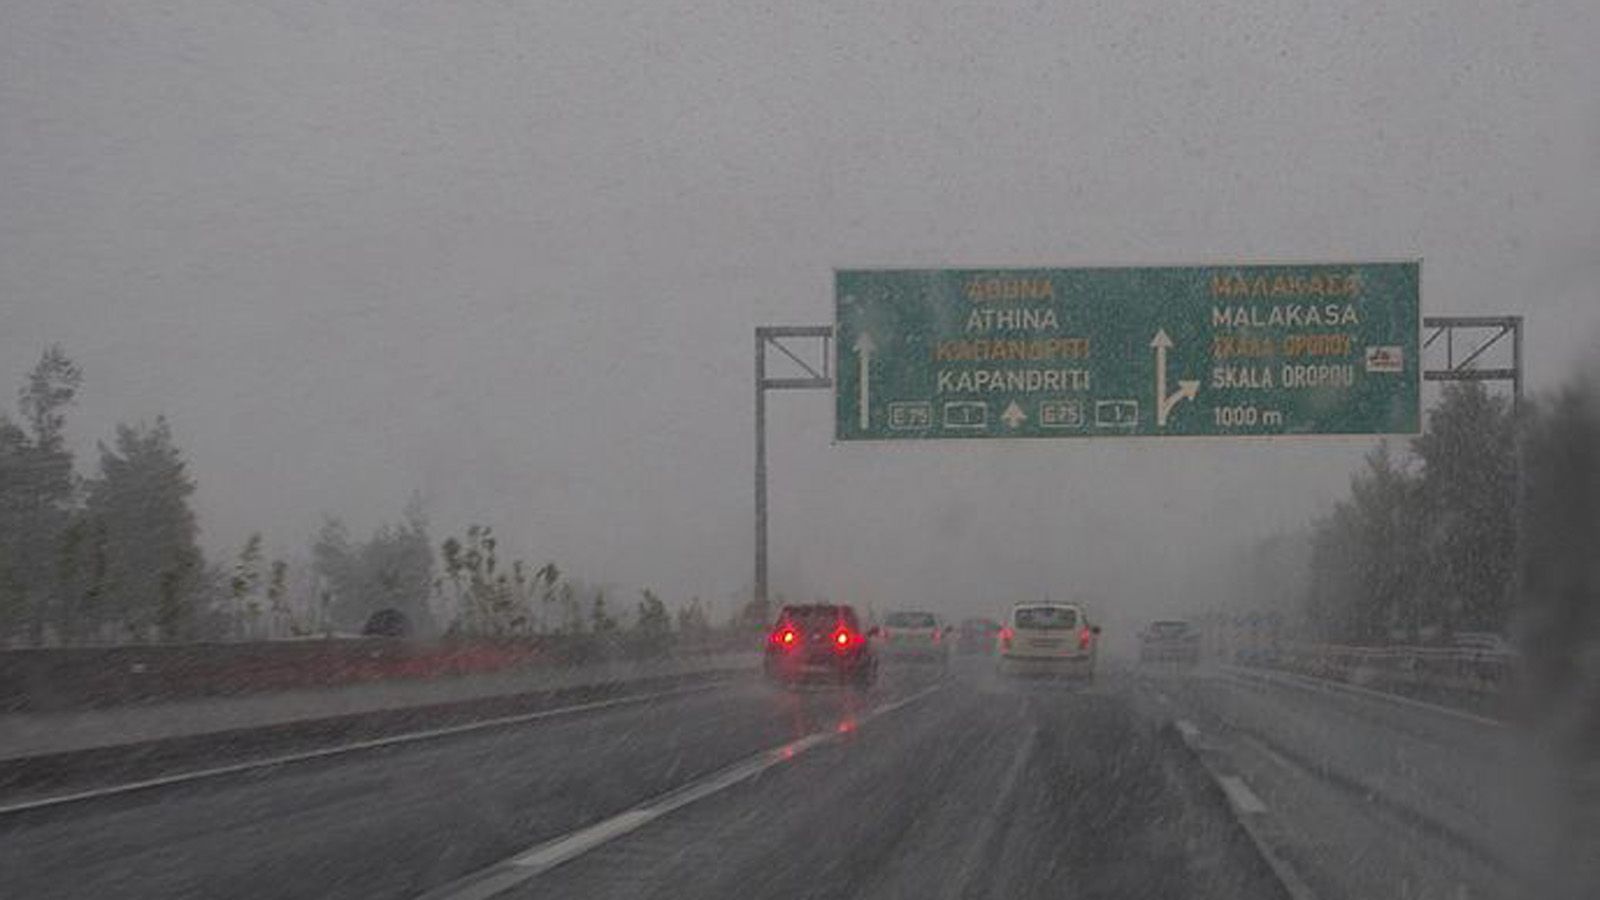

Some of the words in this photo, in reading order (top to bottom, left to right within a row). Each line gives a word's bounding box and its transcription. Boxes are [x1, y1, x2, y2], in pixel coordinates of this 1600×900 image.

[967, 309, 1059, 331] ATHINA
[1212, 304, 1359, 327] MALAKASA
[936, 369, 1091, 393] KAPANDRITI
[1211, 366, 1272, 389] SKALA
[1282, 364, 1353, 388] OROPOU
[1214, 406, 1258, 426] 1000
[1262, 410, 1283, 425] m
